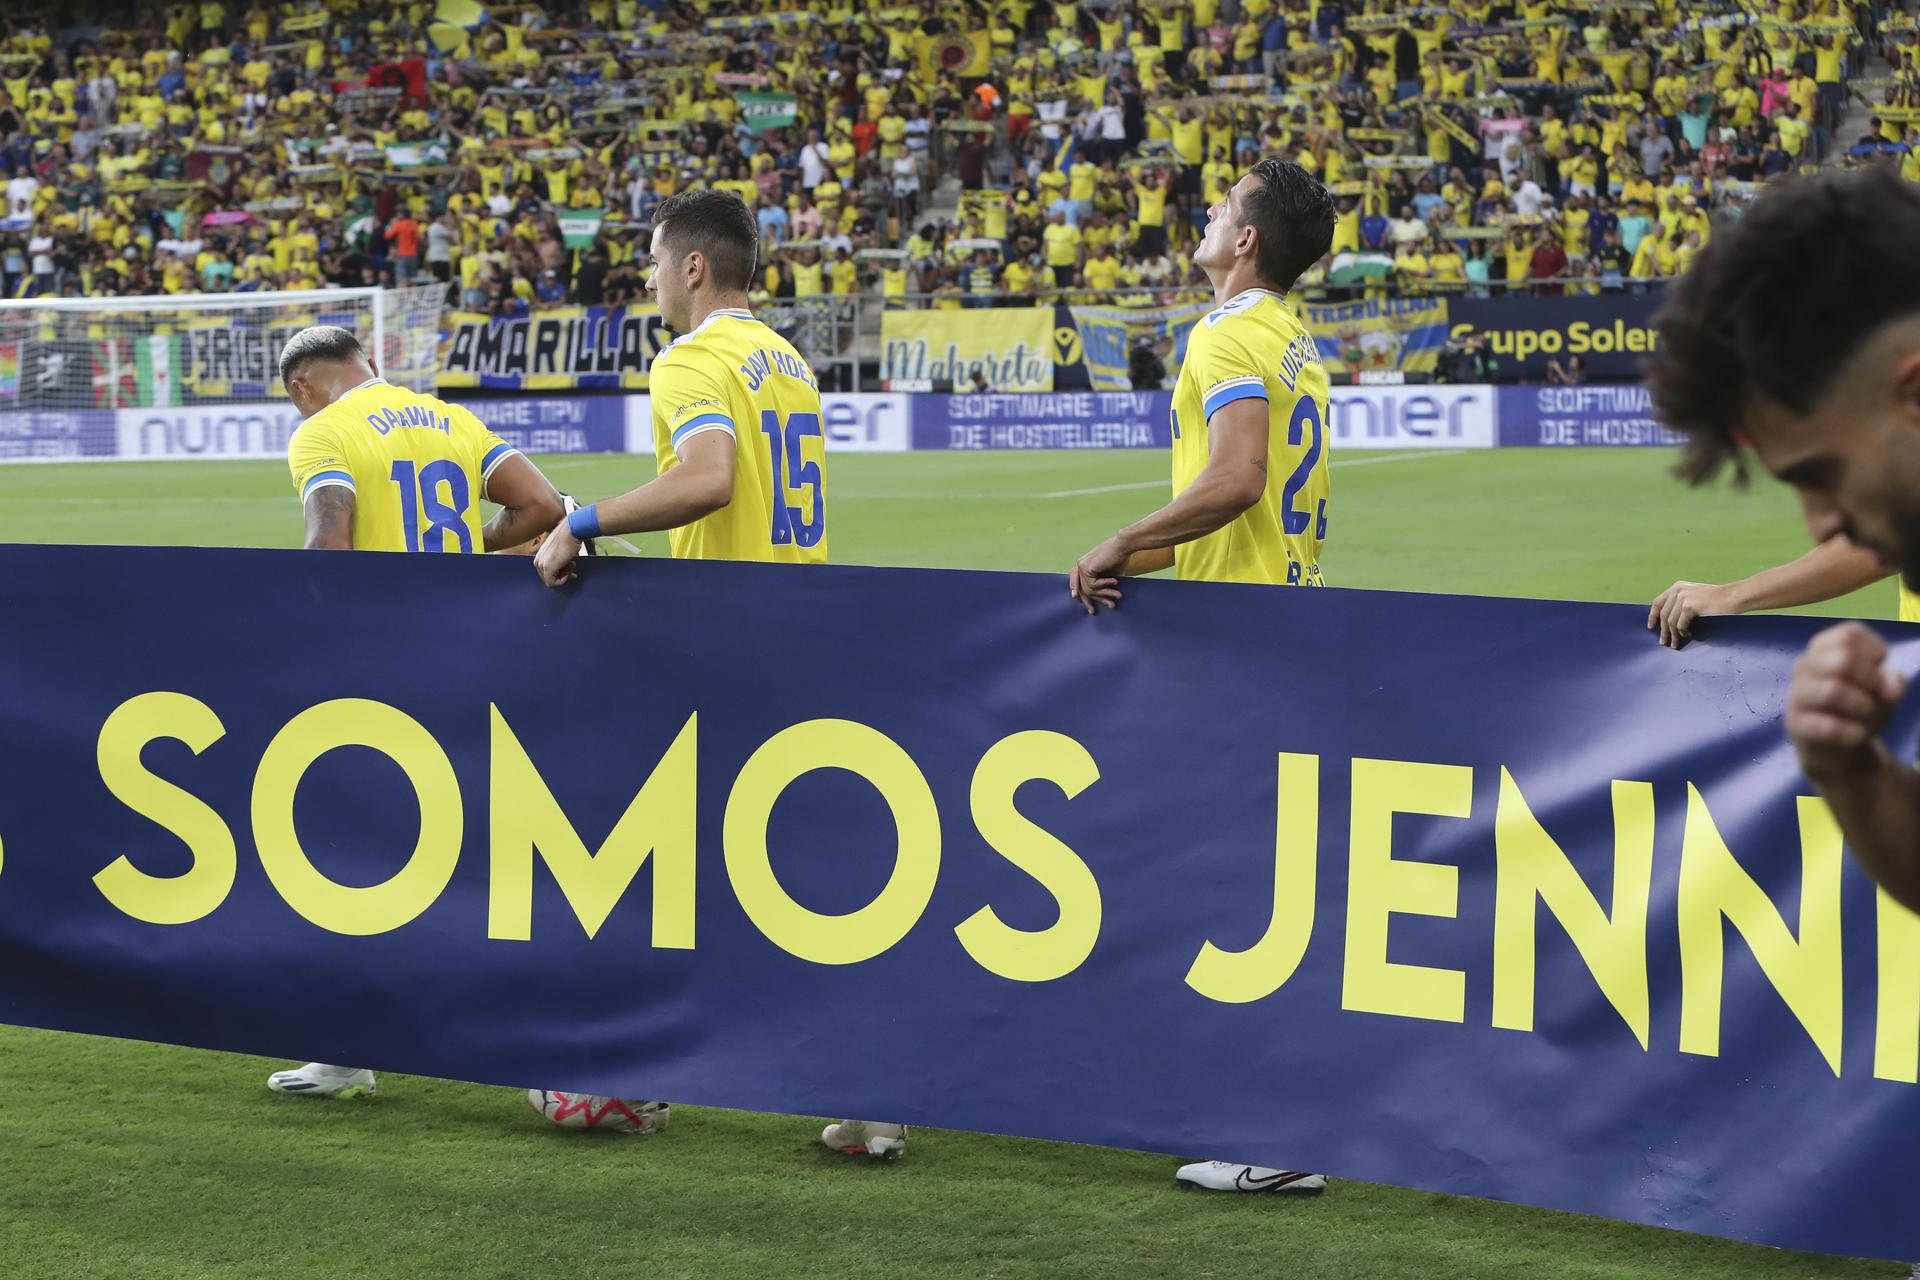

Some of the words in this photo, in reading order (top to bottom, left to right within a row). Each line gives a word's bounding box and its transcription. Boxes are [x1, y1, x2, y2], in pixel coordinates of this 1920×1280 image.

[949, 395, 1094, 418] SOFTWARE
[1099, 393, 1151, 416] TPV
[1330, 396, 1478, 438] mier
[1537, 387, 1653, 413] SOFTWA
[139, 413, 300, 454] numi
[950, 424, 986, 448] DE
[1539, 418, 1578, 445] DE
[761, 409, 825, 548] 15
[390, 459, 473, 554] 18
[91, 690, 1103, 983] SOMOS
